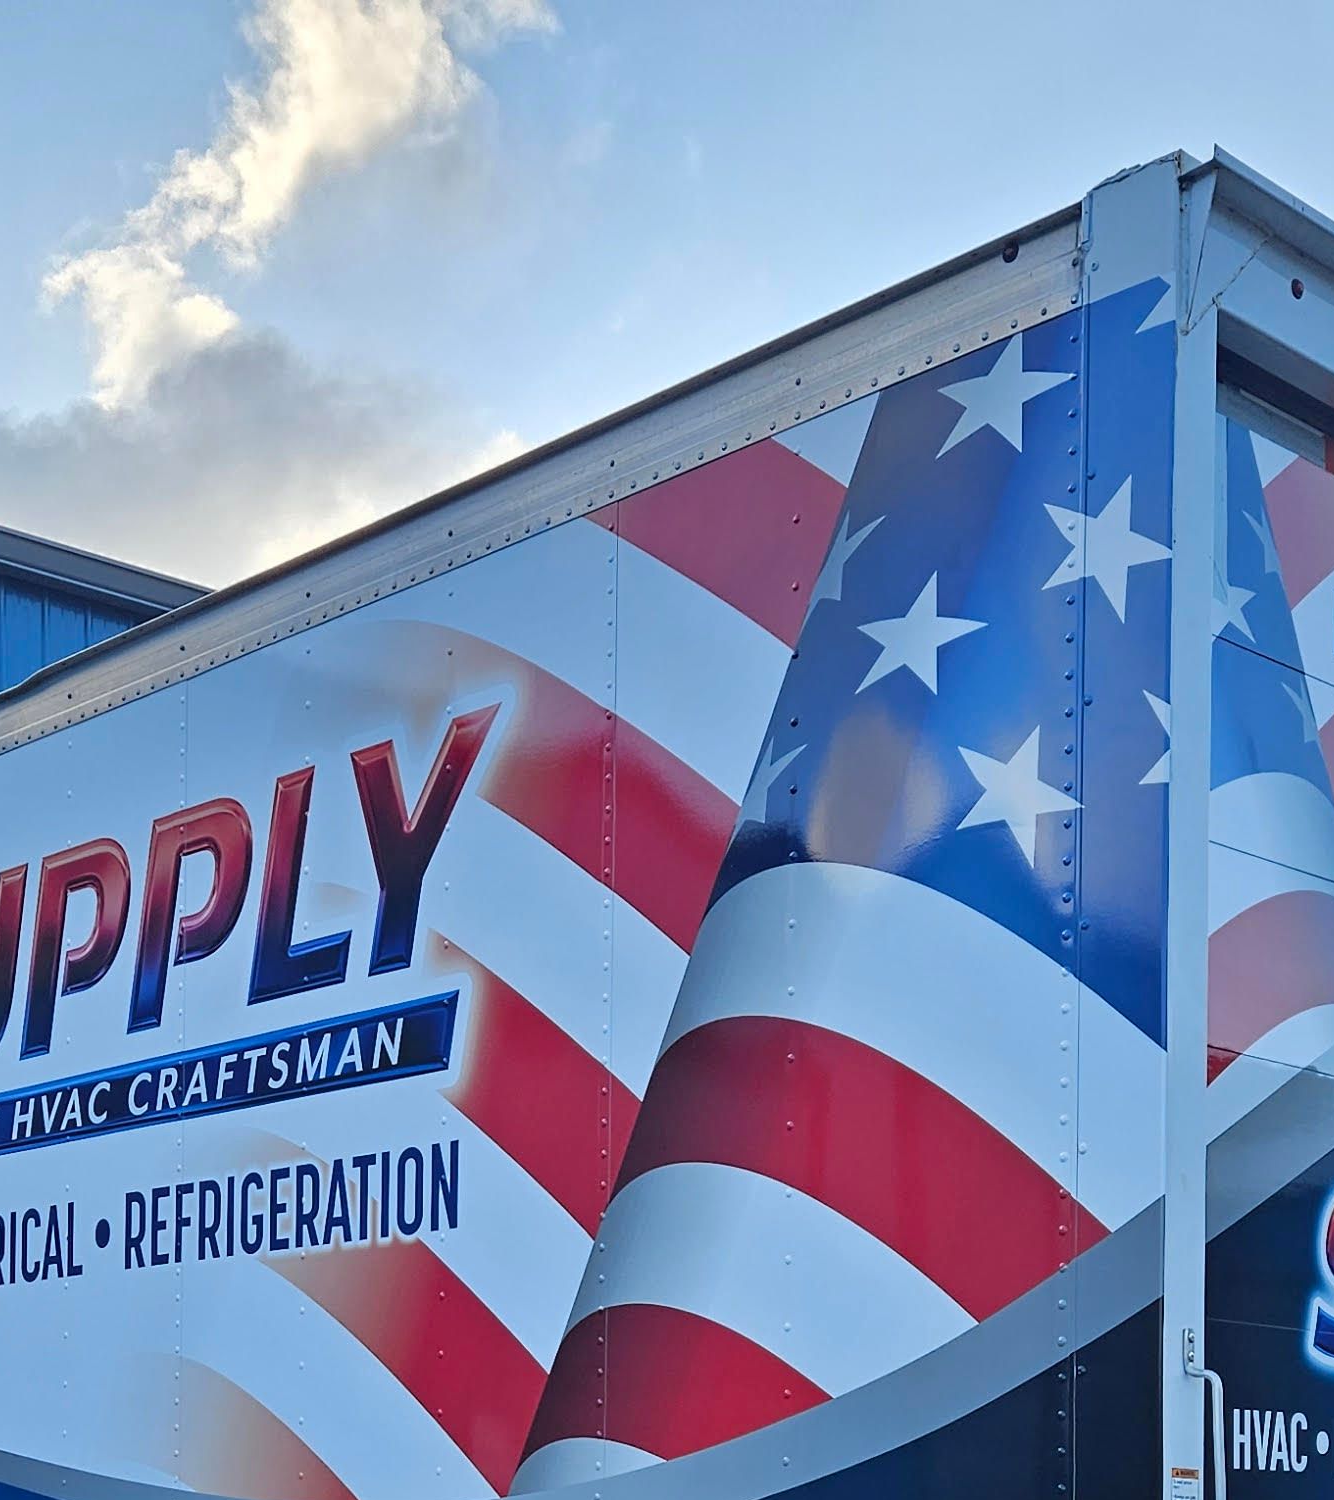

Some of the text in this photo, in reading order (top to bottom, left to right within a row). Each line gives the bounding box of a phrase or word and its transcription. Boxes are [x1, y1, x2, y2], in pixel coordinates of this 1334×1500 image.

[12, 1086, 115, 1136] HVAC
[128, 1016, 405, 1117] CRAFTSMAN
[123, 1140, 460, 1271] REFRIGERATION
[1232, 1407, 1309, 1473] HVAC
